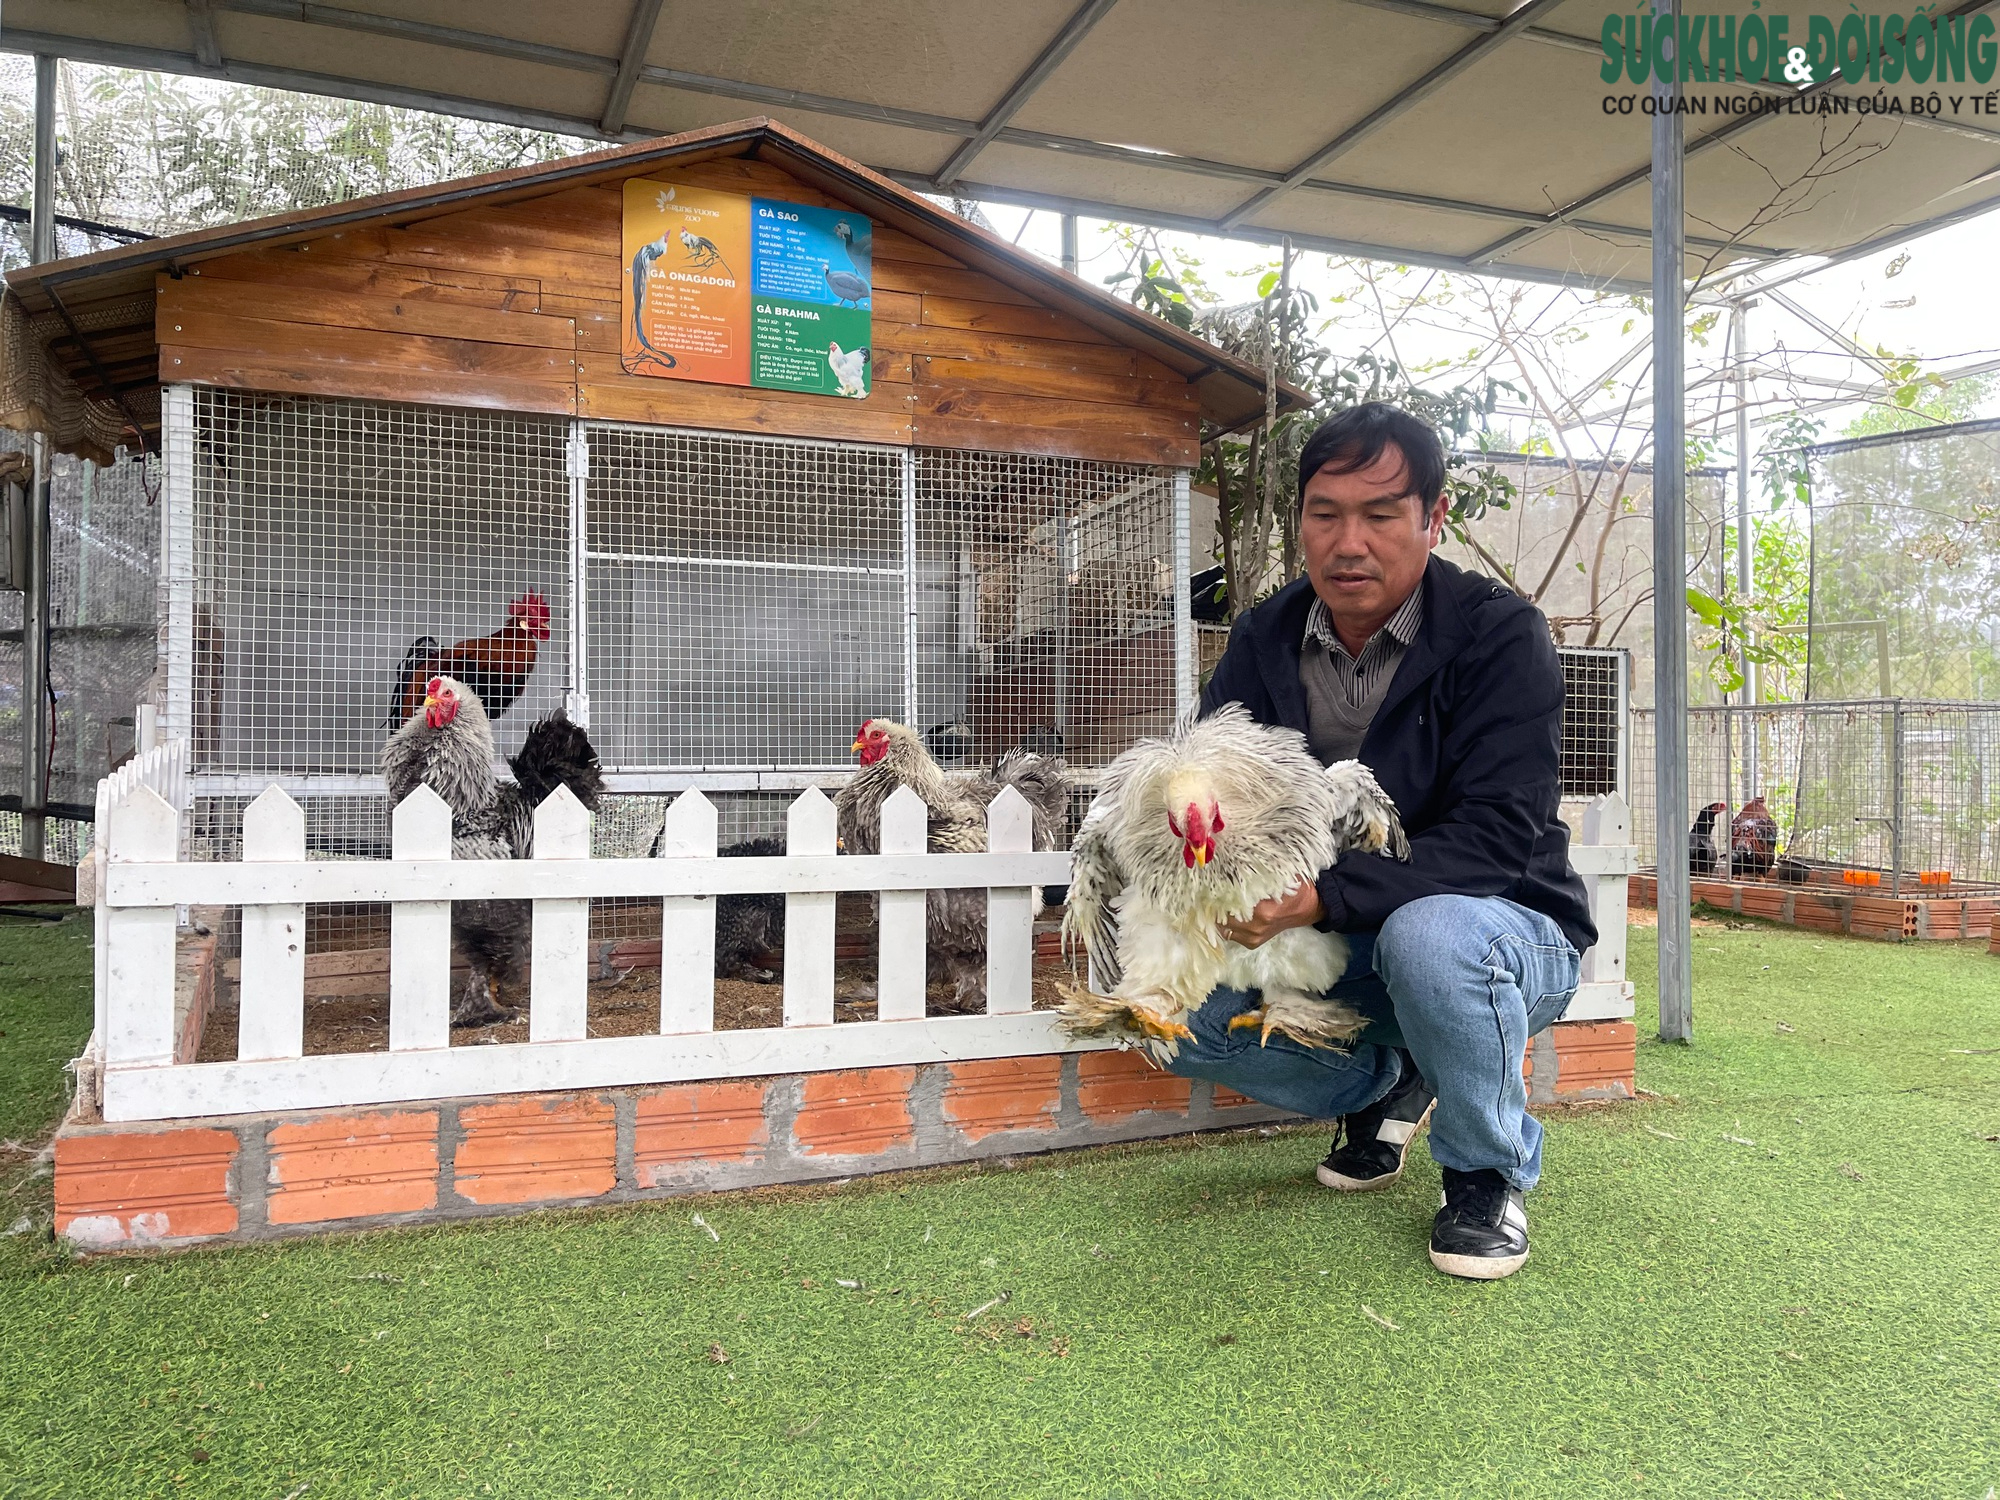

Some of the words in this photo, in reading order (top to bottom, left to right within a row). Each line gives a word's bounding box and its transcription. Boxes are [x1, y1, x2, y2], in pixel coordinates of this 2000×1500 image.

[759, 208, 774, 218] GÀ
[778, 212, 798, 221] SAO
[651, 269, 666, 278] GÀ
[669, 272, 735, 287] ONAGADORI
[756, 304, 772, 314] GÀ
[775, 307, 820, 320] BRAHMA
